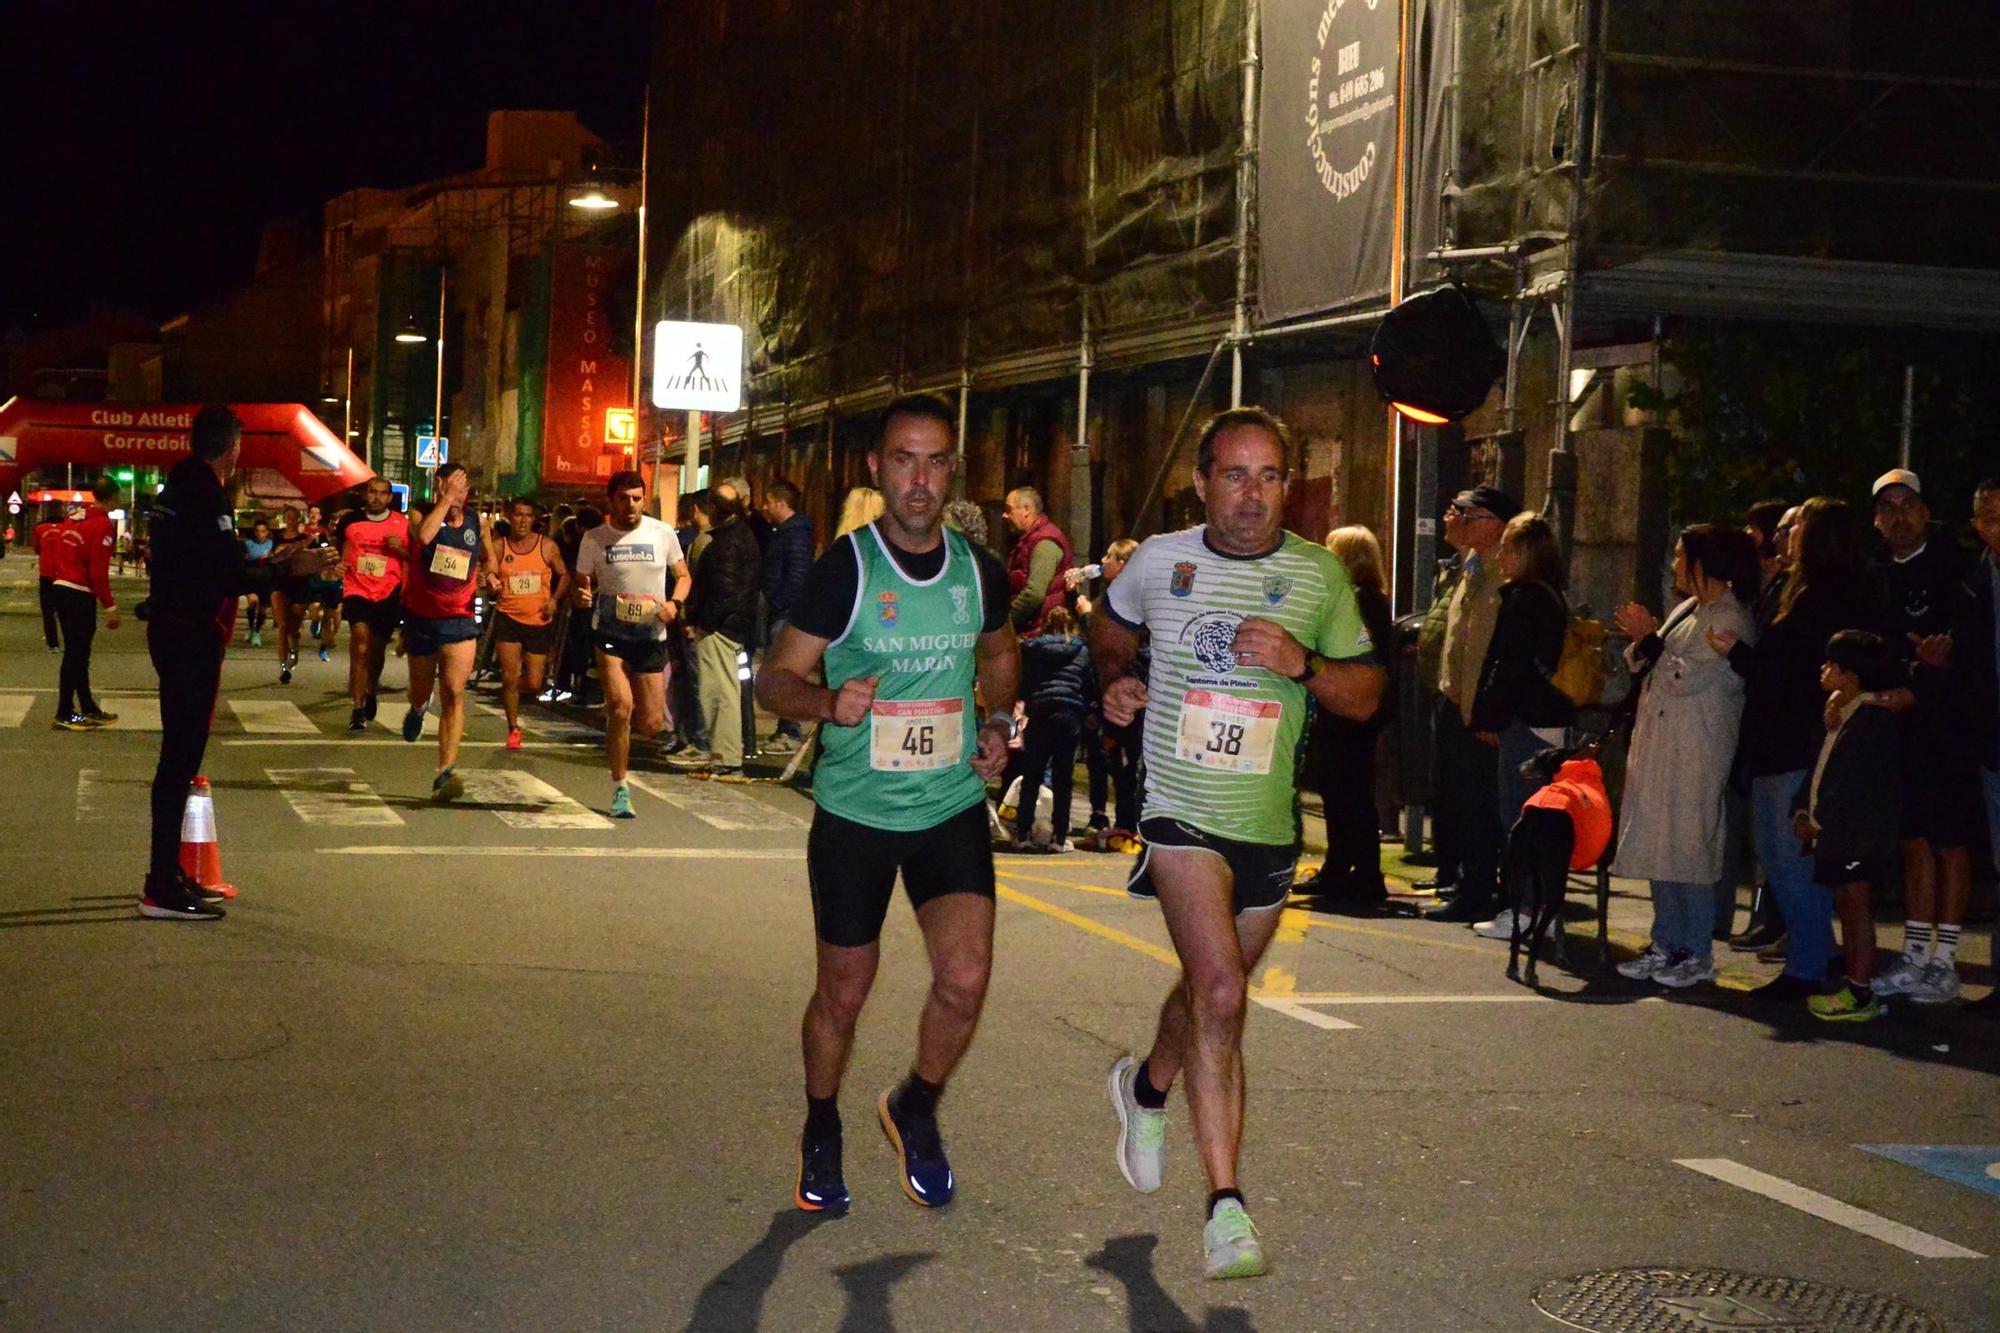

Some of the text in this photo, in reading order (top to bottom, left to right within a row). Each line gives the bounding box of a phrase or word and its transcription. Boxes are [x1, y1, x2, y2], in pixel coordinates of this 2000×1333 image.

[584, 254, 599, 345] MUSEO
[578, 359, 598, 449] MASSÓ
[91, 410, 134, 426] Club
[443, 557, 457, 572] 54
[518, 578, 530, 590] 29
[627, 603, 643, 617] 69
[863, 637, 904, 653] SAN
[1219, 679, 1229, 687] de
[901, 725, 934, 756] 46
[1206, 720, 1245, 756] 38
